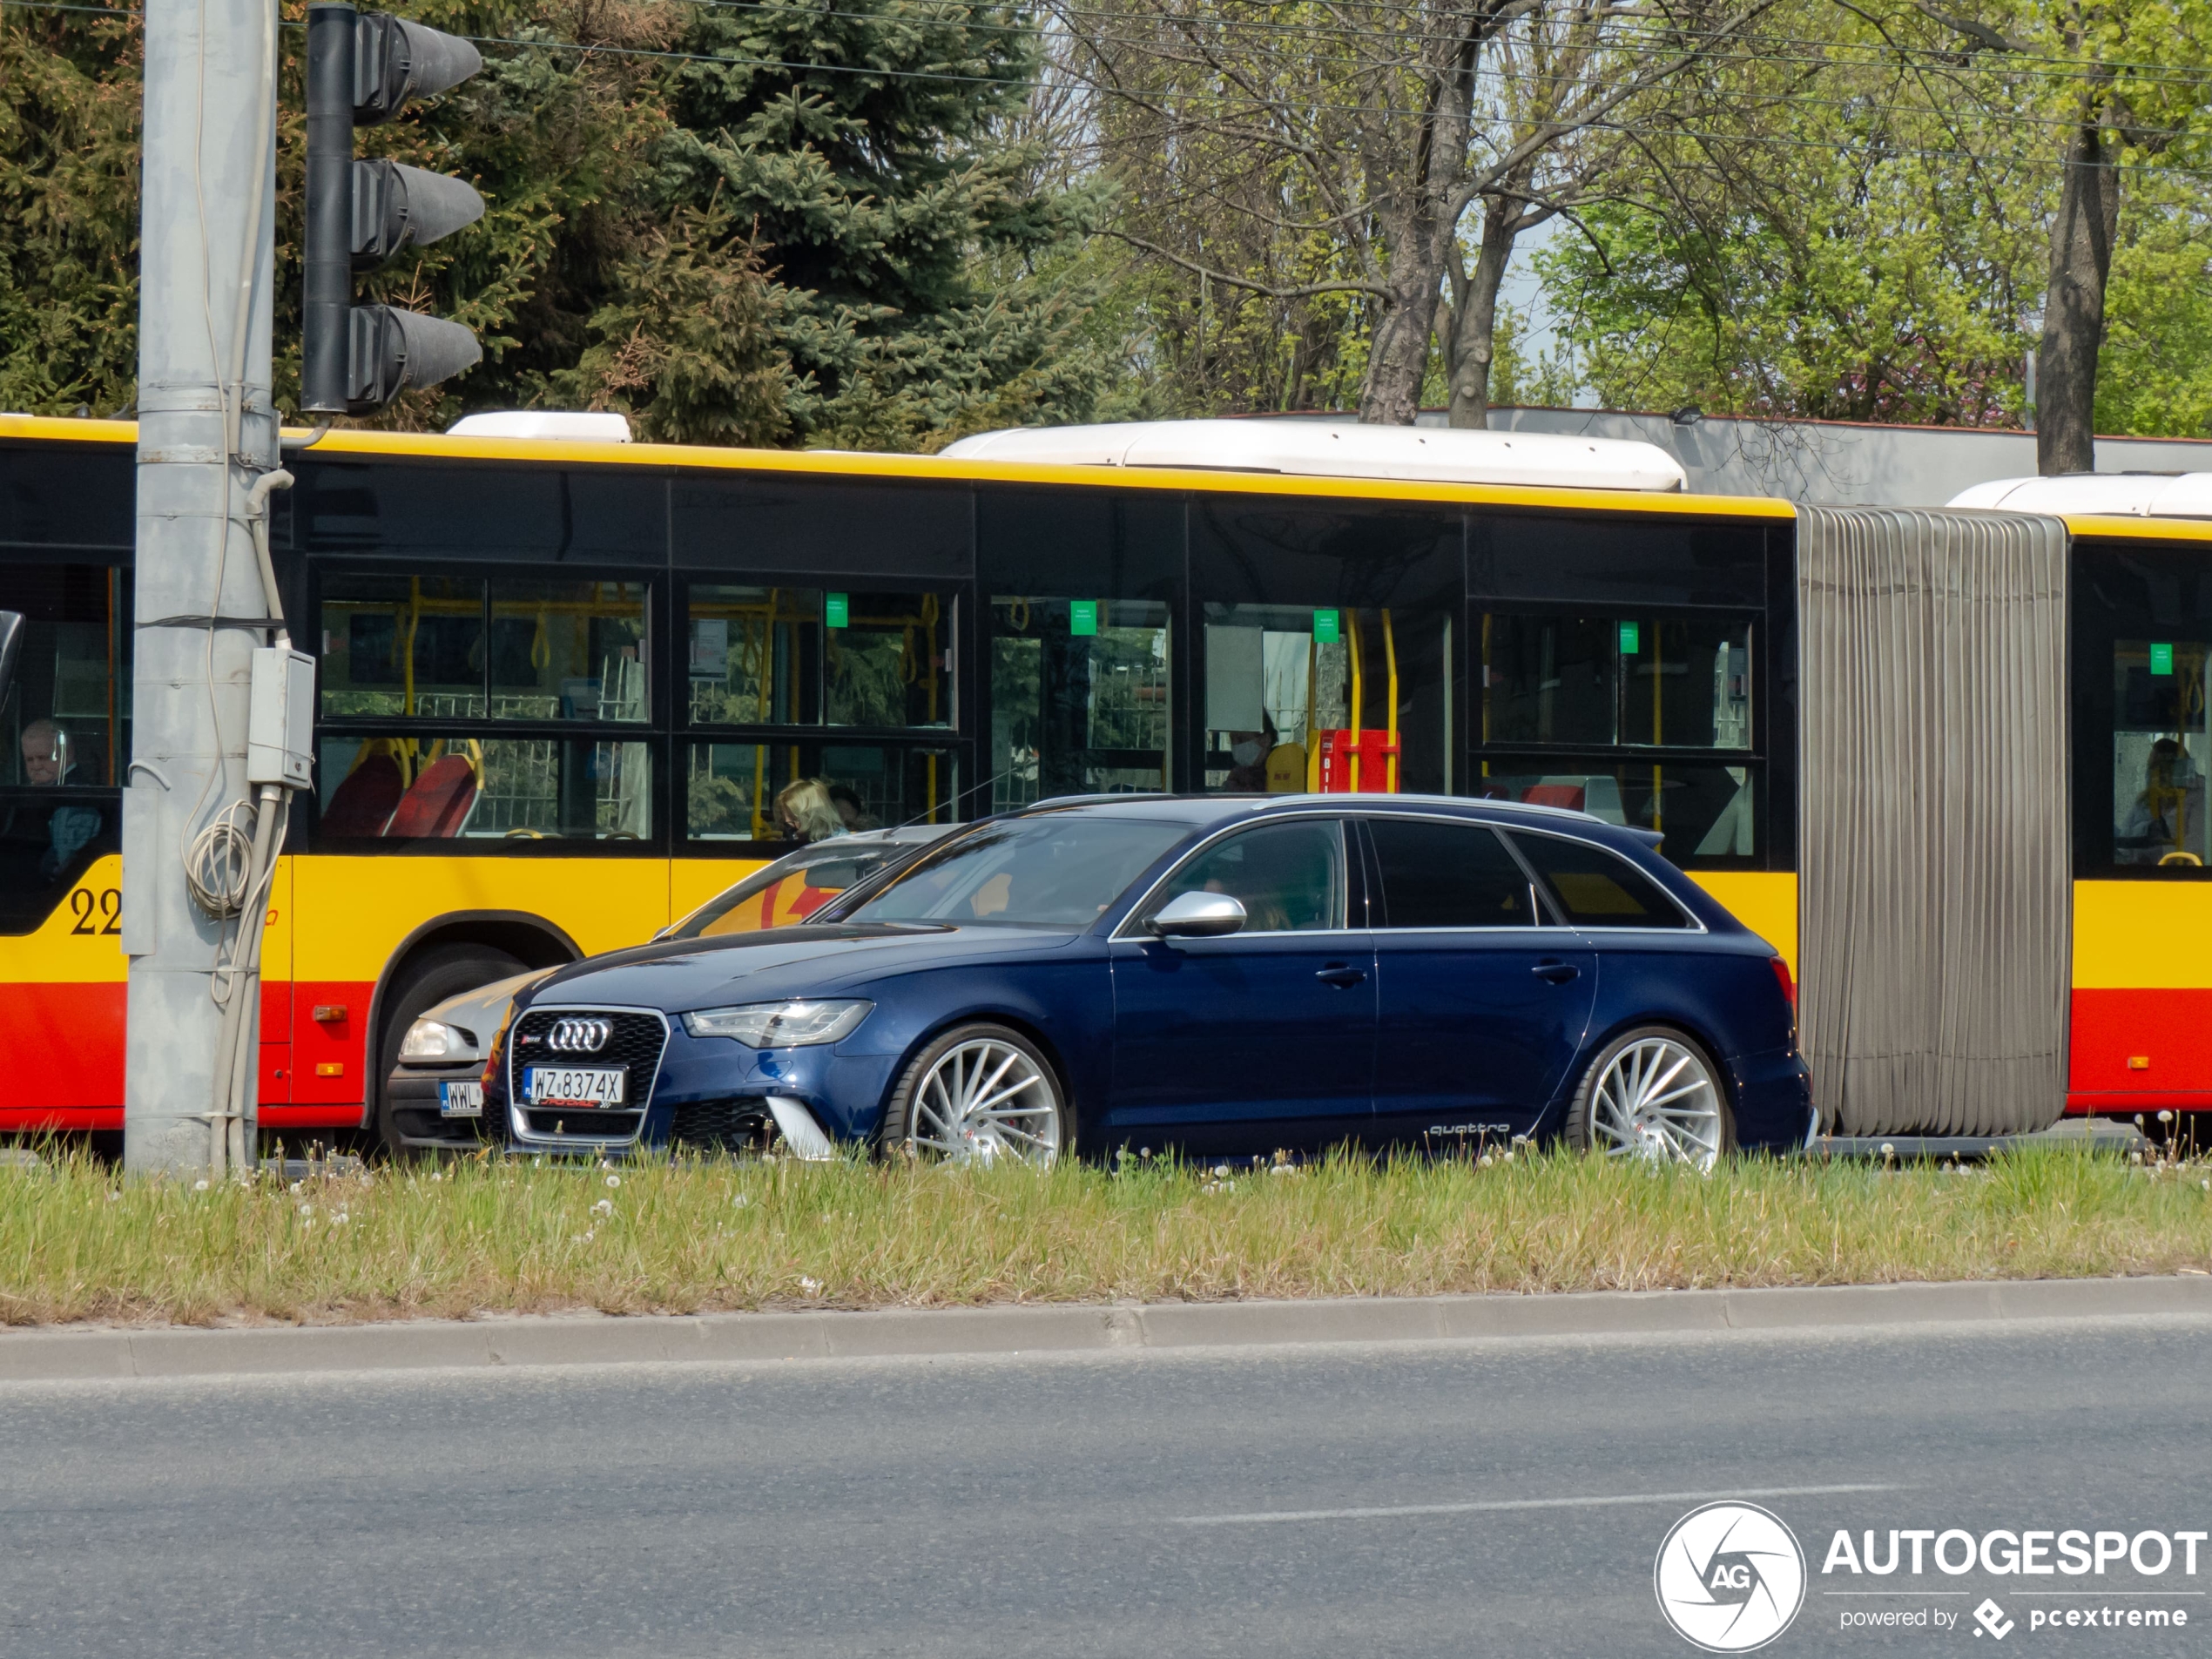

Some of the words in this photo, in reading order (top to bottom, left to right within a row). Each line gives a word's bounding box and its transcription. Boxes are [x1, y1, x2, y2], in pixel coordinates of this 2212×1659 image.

[448, 1084, 477, 1109] WWL
[536, 1071, 556, 1097] WZ
[563, 1072, 618, 1100] 8374X
[1430, 1123, 1510, 1136] quattro
